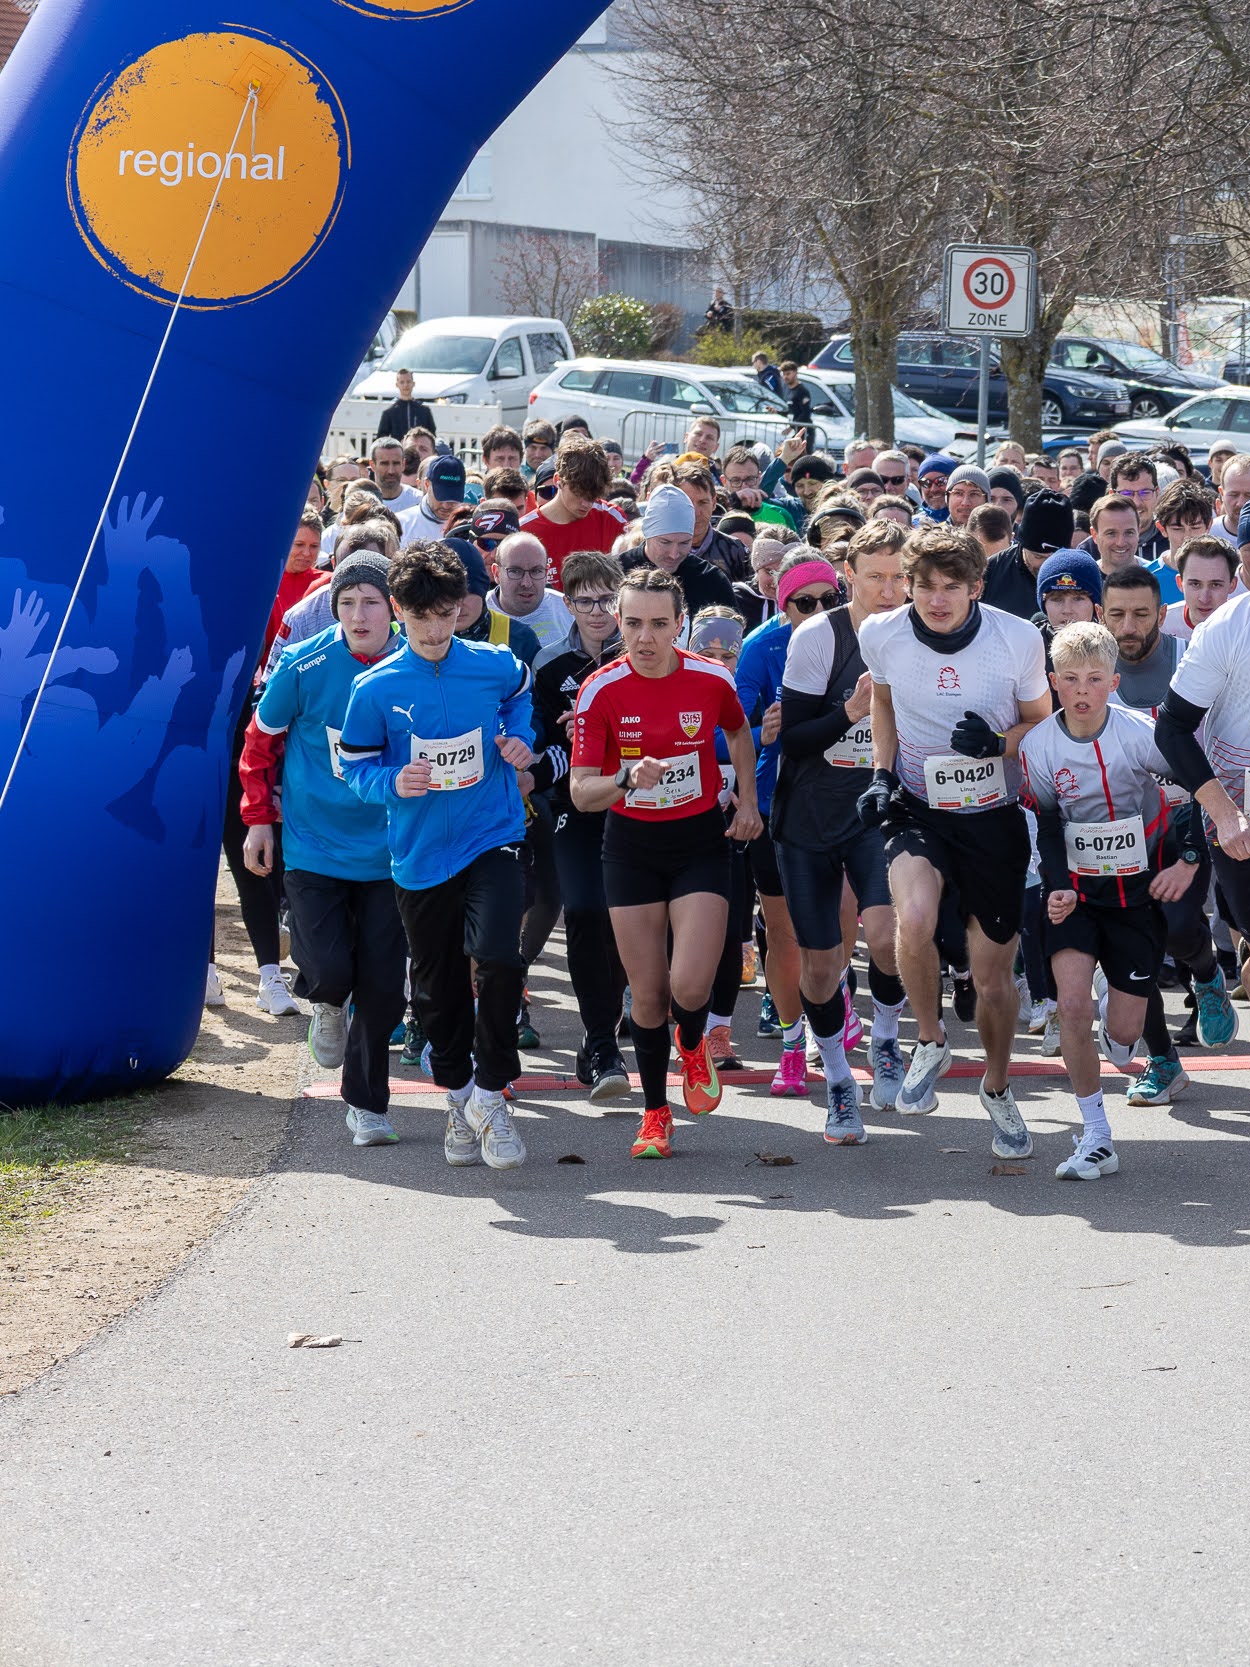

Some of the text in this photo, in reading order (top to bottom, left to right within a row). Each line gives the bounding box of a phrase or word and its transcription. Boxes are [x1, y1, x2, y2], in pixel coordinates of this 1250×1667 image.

[118, 142, 285, 187] regional
[974, 271, 1004, 296] 30
[967, 312, 1008, 327] ZONE
[296, 653, 327, 674] Kempa
[560, 683, 581, 692] adidas
[621, 716, 641, 724] JAKO
[627, 731, 643, 739] MHP
[935, 762, 995, 786] 6-0420
[1074, 832, 1136, 852] 6-0720
